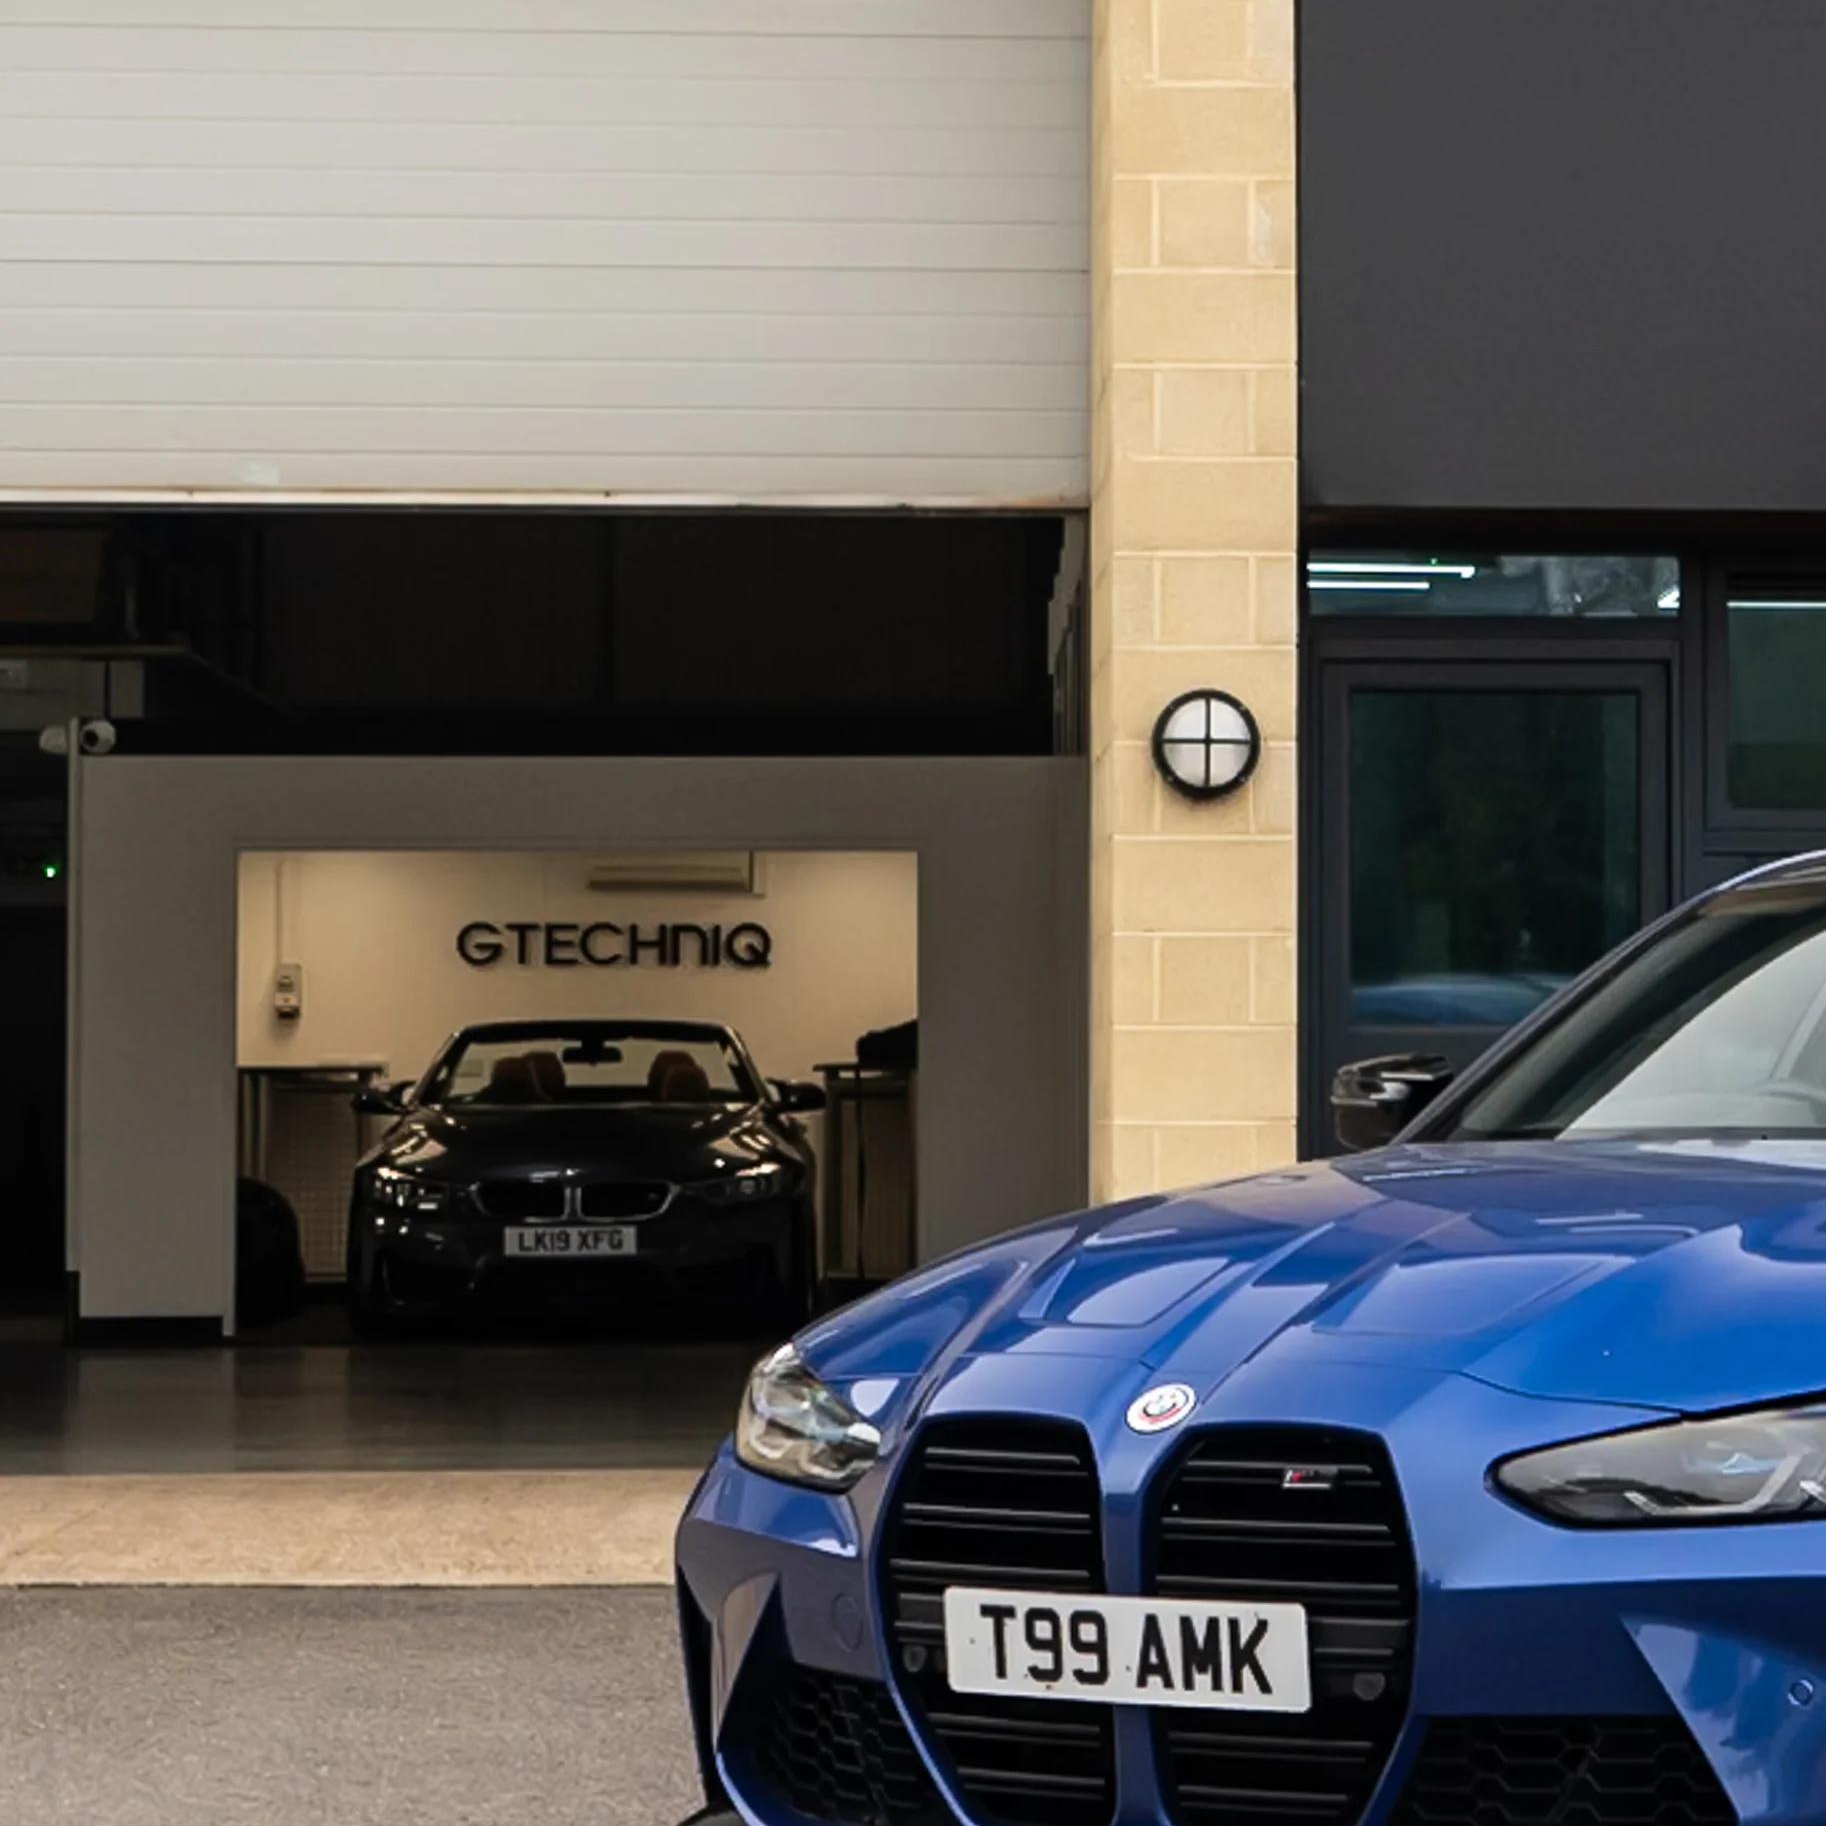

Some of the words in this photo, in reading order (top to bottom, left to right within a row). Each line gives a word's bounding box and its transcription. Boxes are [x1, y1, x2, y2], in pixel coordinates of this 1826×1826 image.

[456, 922, 771, 967] GTECHNIQ
[518, 1230, 570, 1252] LK19
[979, 1603, 1111, 1685] T99
[1135, 1612, 1273, 1695] AMK
